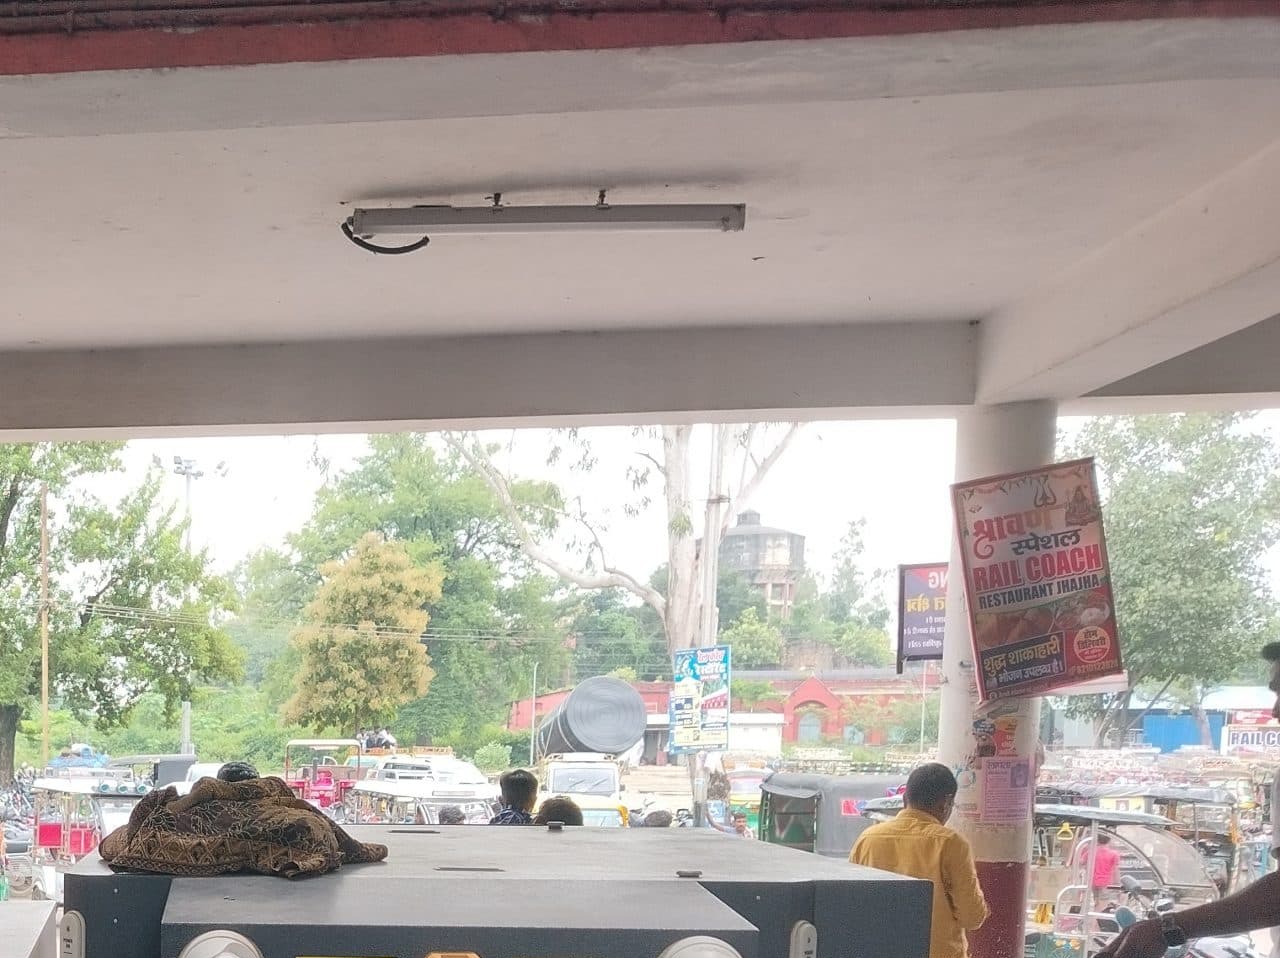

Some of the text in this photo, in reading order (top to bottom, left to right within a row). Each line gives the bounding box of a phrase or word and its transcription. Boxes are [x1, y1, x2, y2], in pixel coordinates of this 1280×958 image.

[1010, 529, 1081, 555] स्पेशल
[973, 544, 1103, 591] RAIL COACH
[979, 574, 1100, 610] RESTAURANT JHAJHA
[1008, 635, 1060, 665] शाकाहारी
[1231, 731, 1280, 747] RAIL C
